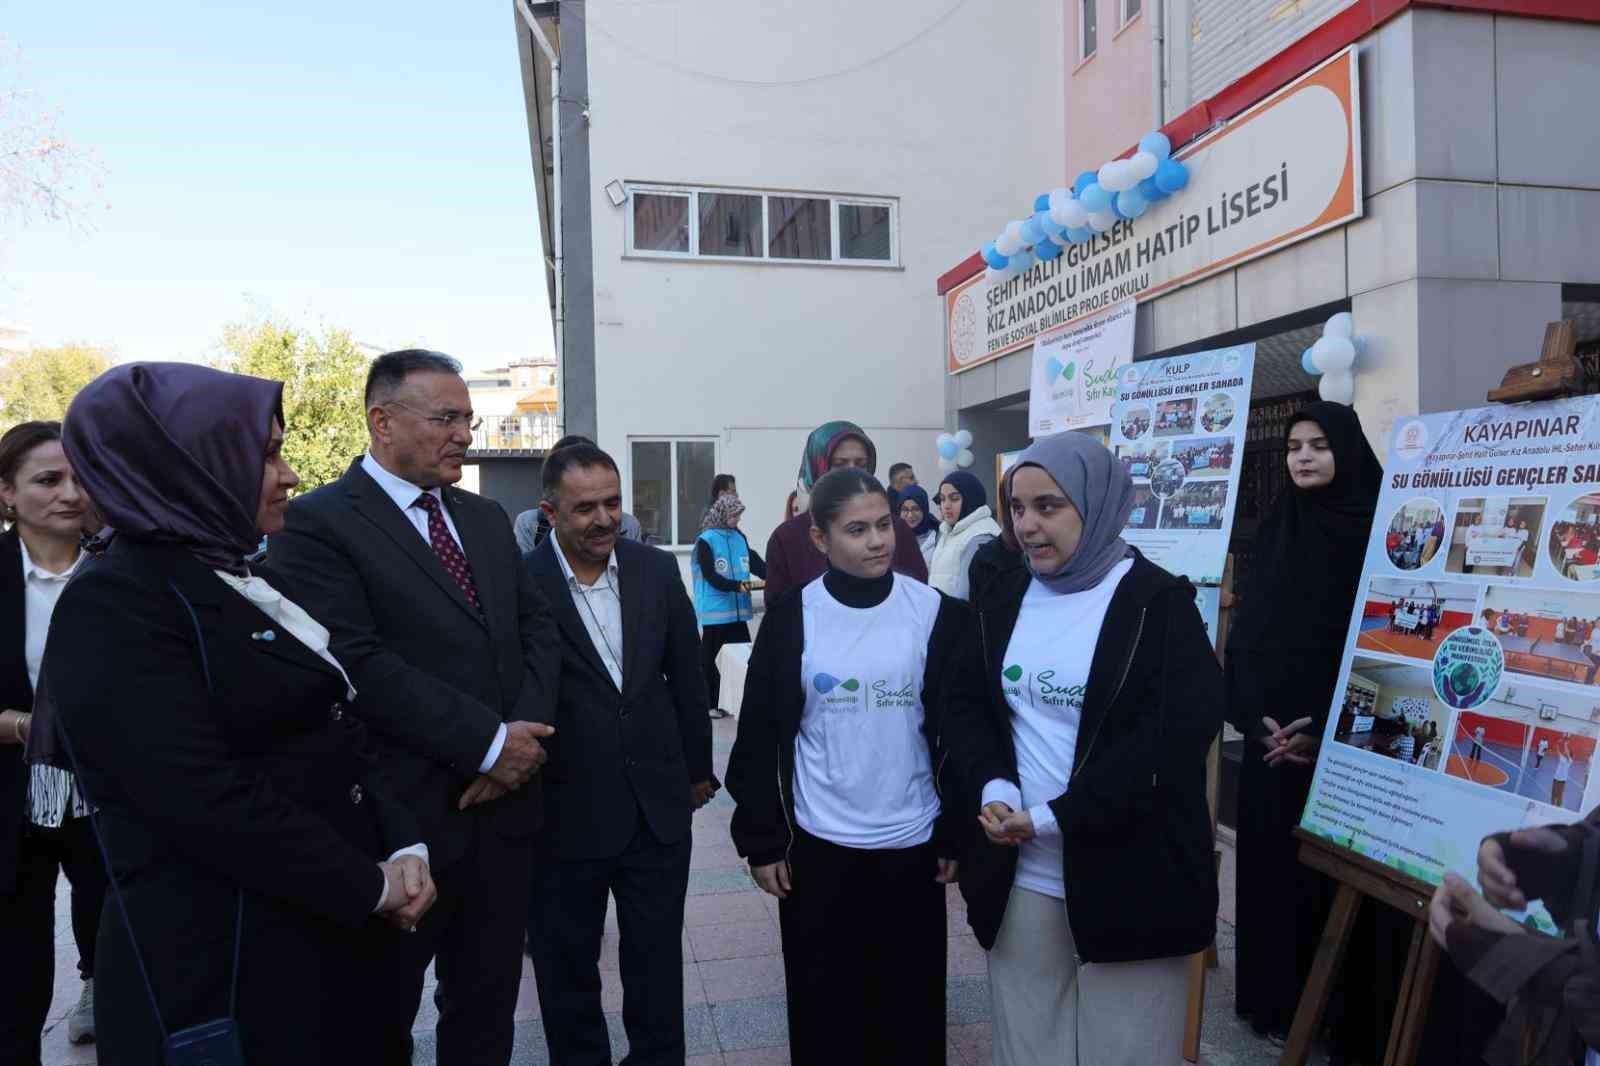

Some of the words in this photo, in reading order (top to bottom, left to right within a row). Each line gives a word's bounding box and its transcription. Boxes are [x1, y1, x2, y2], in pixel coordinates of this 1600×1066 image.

[987, 309, 1006, 335] KIZ
[1008, 274, 1077, 326] ANADOLU
[1081, 248, 1132, 293] İMAM
[1137, 213, 1200, 268] HATİP
[1207, 161, 1288, 236] LİSESİ
[987, 338, 1000, 353] FEN
[1010, 321, 1038, 343] SOSYAL
[1080, 290, 1109, 317] PROJE
[1111, 273, 1149, 301] OKULU
[1165, 363, 1191, 376] KULP
[1210, 377, 1244, 389] SAHADA
[1463, 415, 1580, 443] KAYAPINAR
[1391, 472, 1409, 489] SU
[1412, 466, 1494, 488] GÖNÜLLÜSÜ
[1496, 465, 1568, 491] GENÇLER
